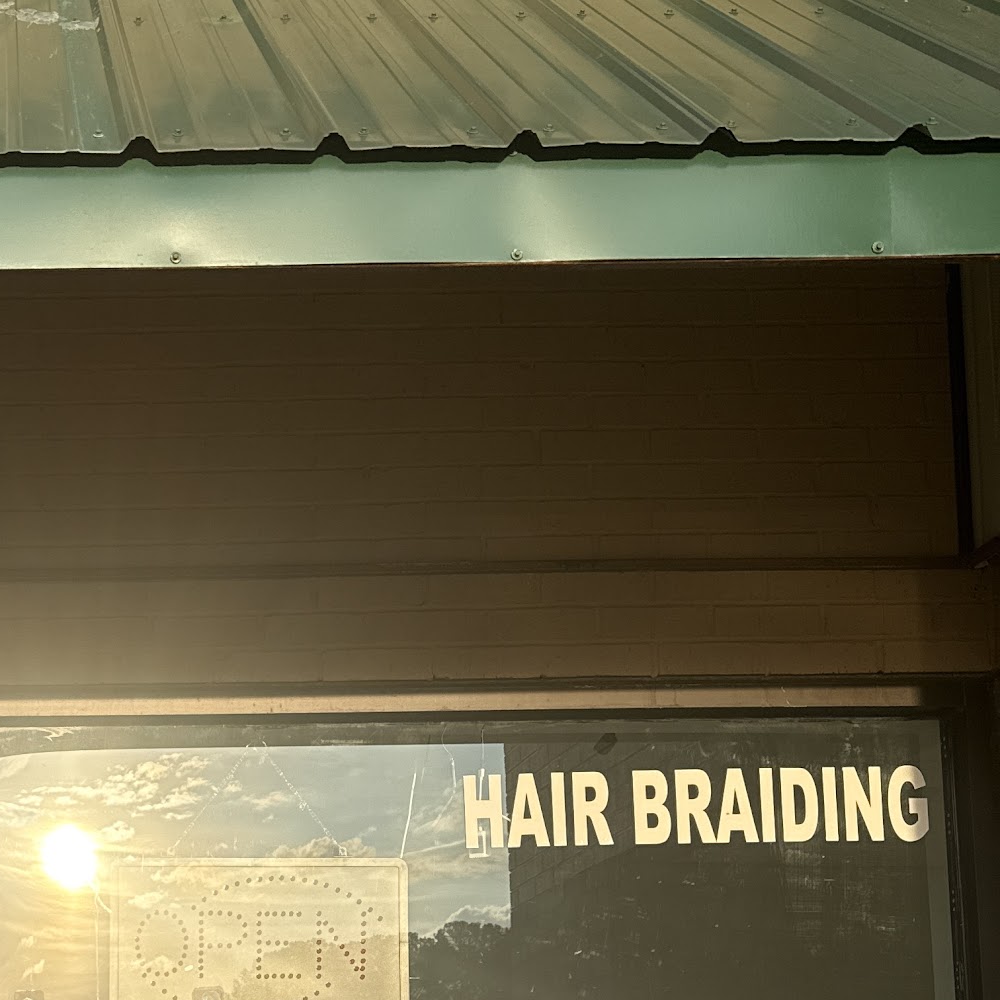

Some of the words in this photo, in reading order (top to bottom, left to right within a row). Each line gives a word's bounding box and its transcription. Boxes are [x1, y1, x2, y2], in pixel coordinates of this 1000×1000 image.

[463, 771, 614, 849] HAIR
[631, 765, 930, 845] BRAIDING
[134, 909, 367, 980] OPEN
